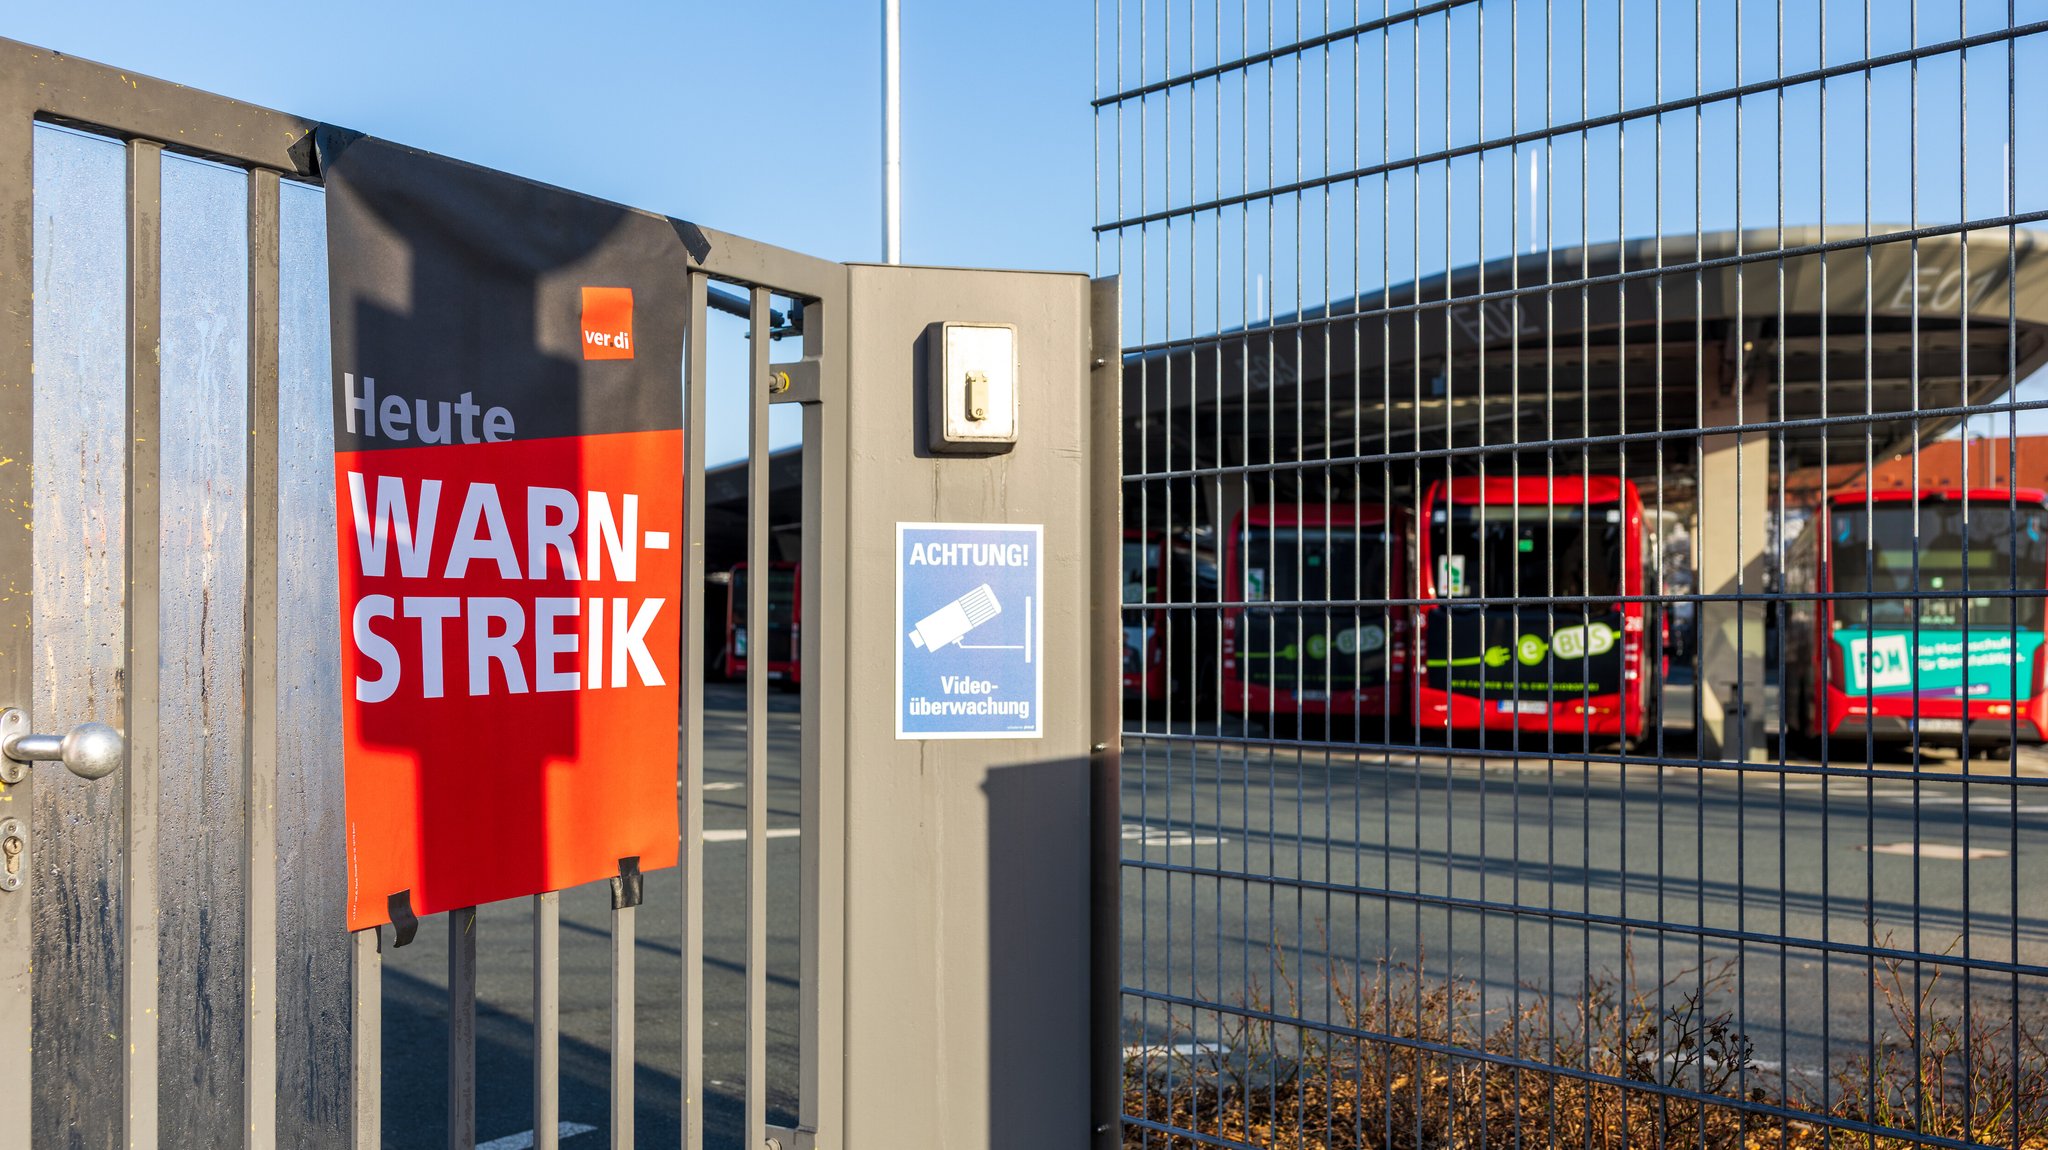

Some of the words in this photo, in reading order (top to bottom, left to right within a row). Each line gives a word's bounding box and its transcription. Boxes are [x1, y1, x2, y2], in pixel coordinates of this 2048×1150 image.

[1891, 267, 1998, 310] E01
[1452, 299, 1540, 342] E02
[584, 330, 629, 349] ver.di
[344, 372, 516, 445] Heute
[347, 471, 670, 582] WARN-
[909, 543, 1029, 567] ACHTUNG!
[352, 594, 667, 703] STREIK
[1521, 641, 1537, 659] e
[941, 676, 998, 694] Video-
[909, 697, 1029, 719] überwachung
